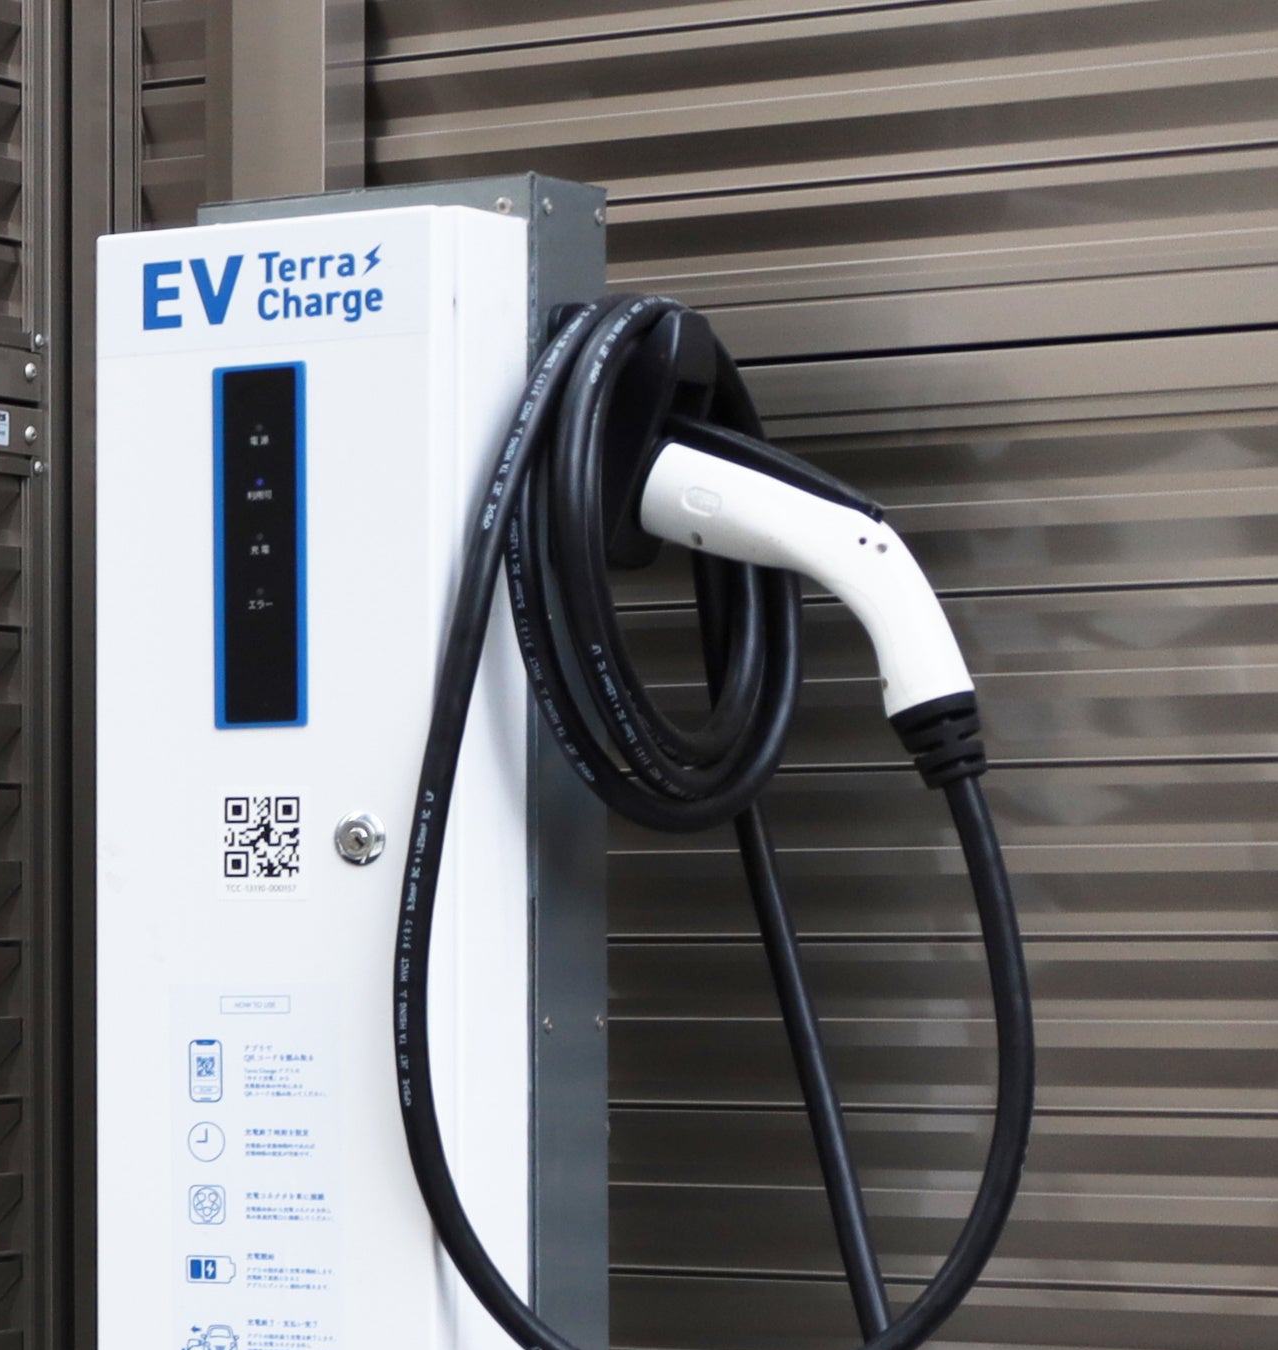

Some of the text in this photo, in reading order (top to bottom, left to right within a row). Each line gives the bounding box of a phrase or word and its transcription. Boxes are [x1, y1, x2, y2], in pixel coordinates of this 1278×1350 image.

[257, 251, 355, 283] Terra
[143, 254, 244, 331] EV
[257, 288, 383, 322] Charge
[498, 463, 510, 474] TA
[250, 544, 270, 555] 充電
[248, 599, 273, 610] エラー
[399, 1002, 407, 1030] HSING
[399, 1033, 407, 1044] TA
[401, 1054, 409, 1069] JET
